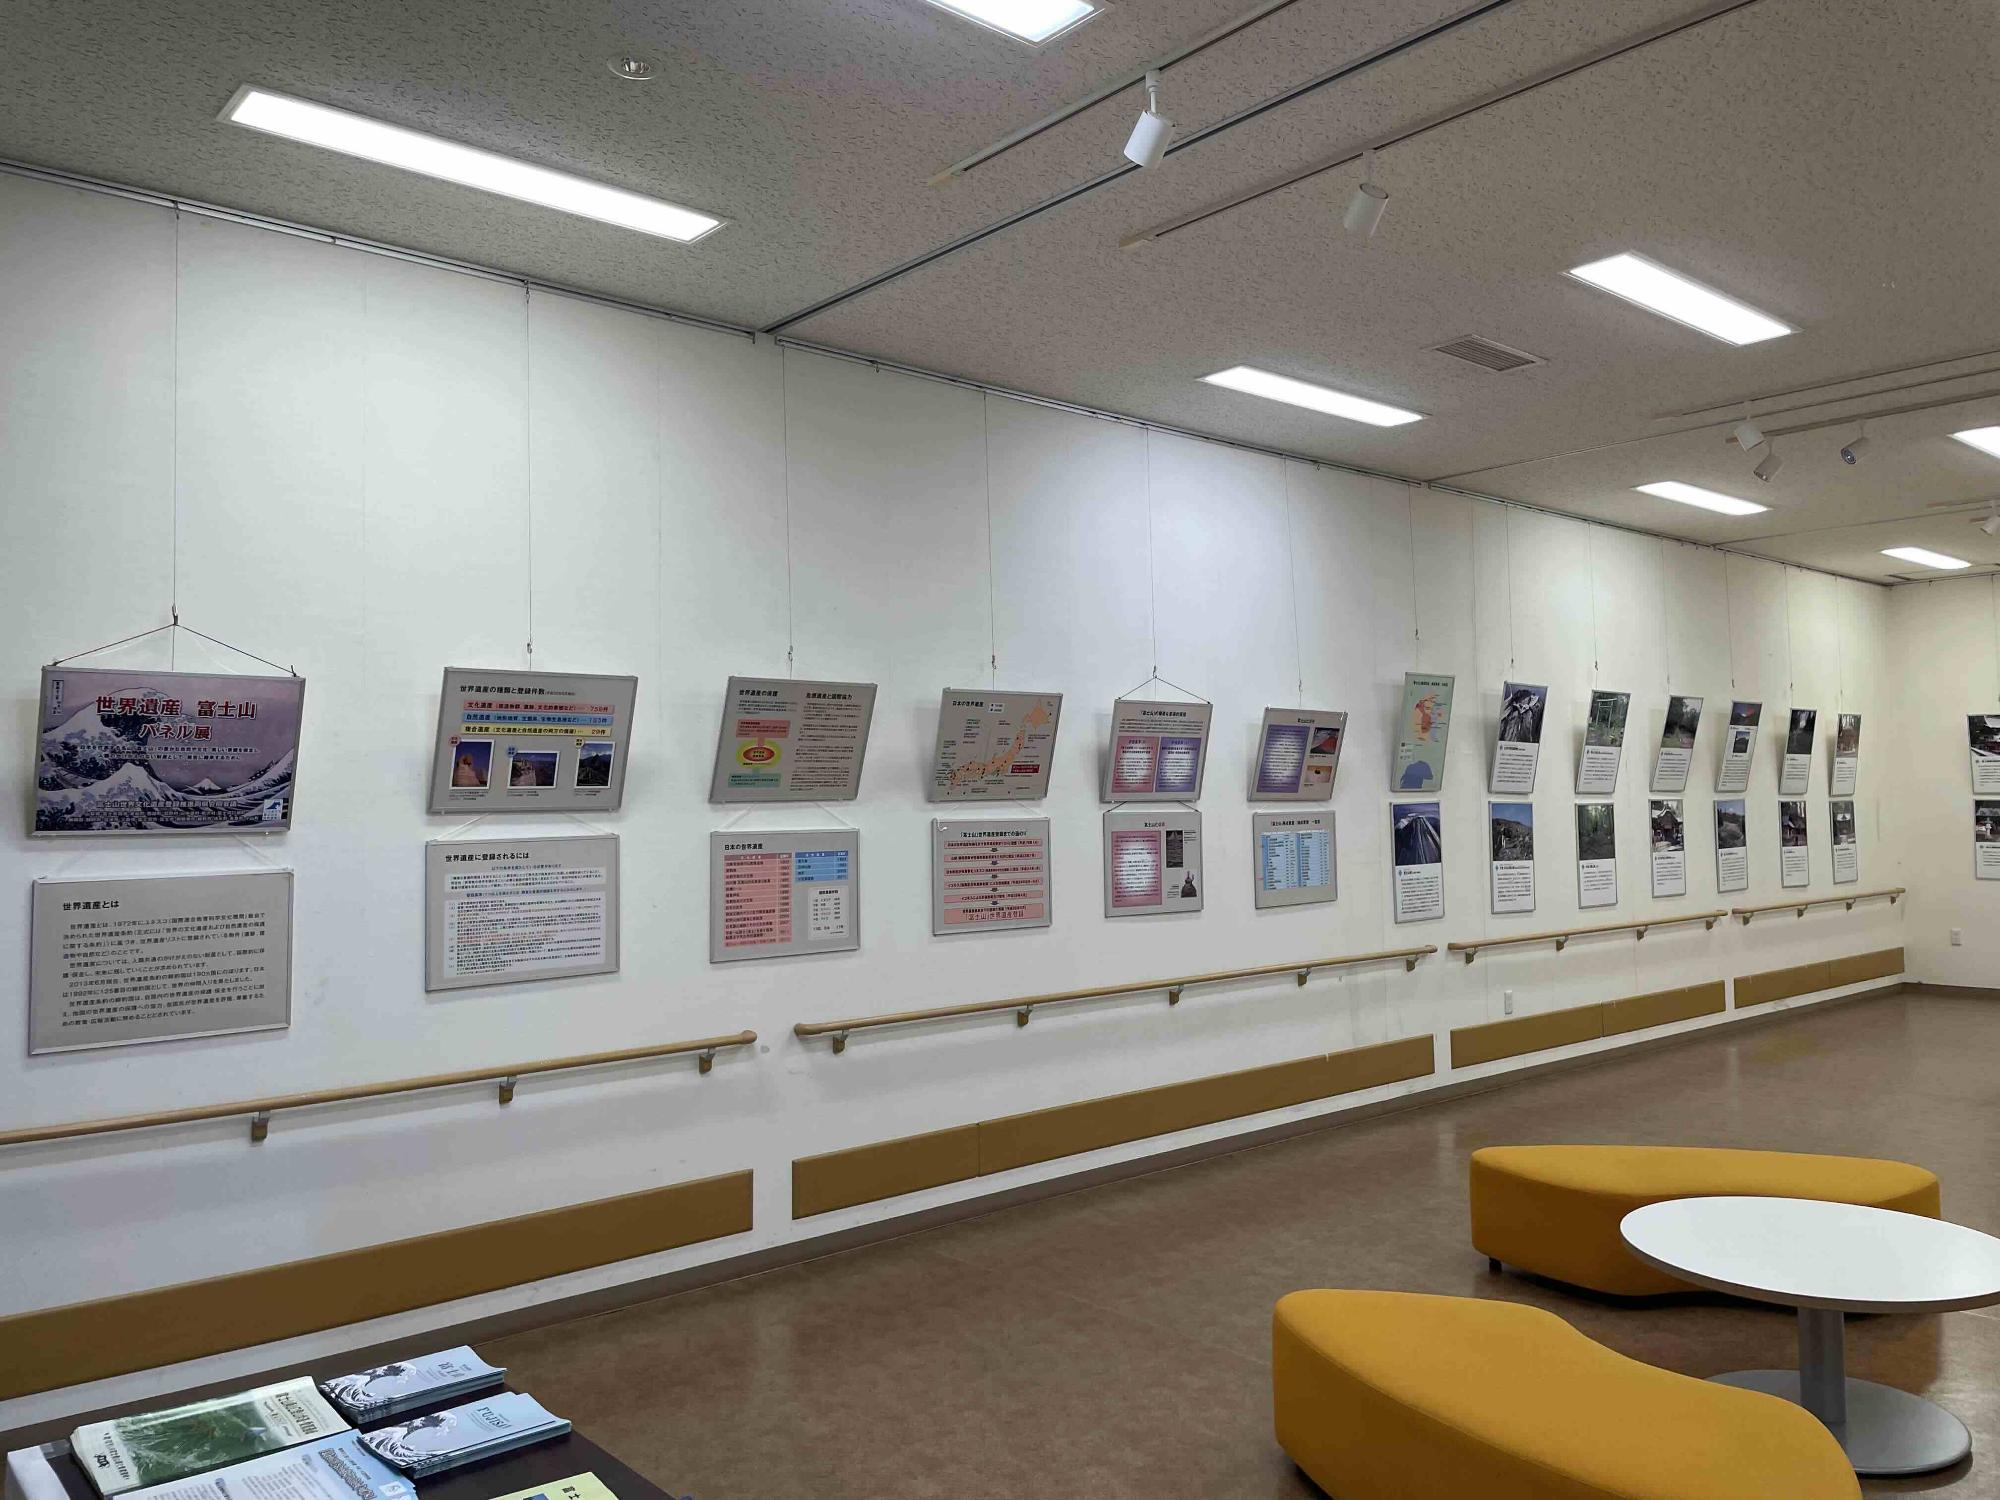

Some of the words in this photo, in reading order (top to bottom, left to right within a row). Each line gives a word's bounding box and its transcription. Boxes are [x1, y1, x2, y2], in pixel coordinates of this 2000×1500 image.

[96, 695, 182, 717] 世界遺産
[197, 699, 258, 720] 富士山
[138, 723, 214, 741] パネル展
[445, 852, 530, 863] 世界遺産に登録されるには
[63, 900, 120, 911] 世界遺産とは
